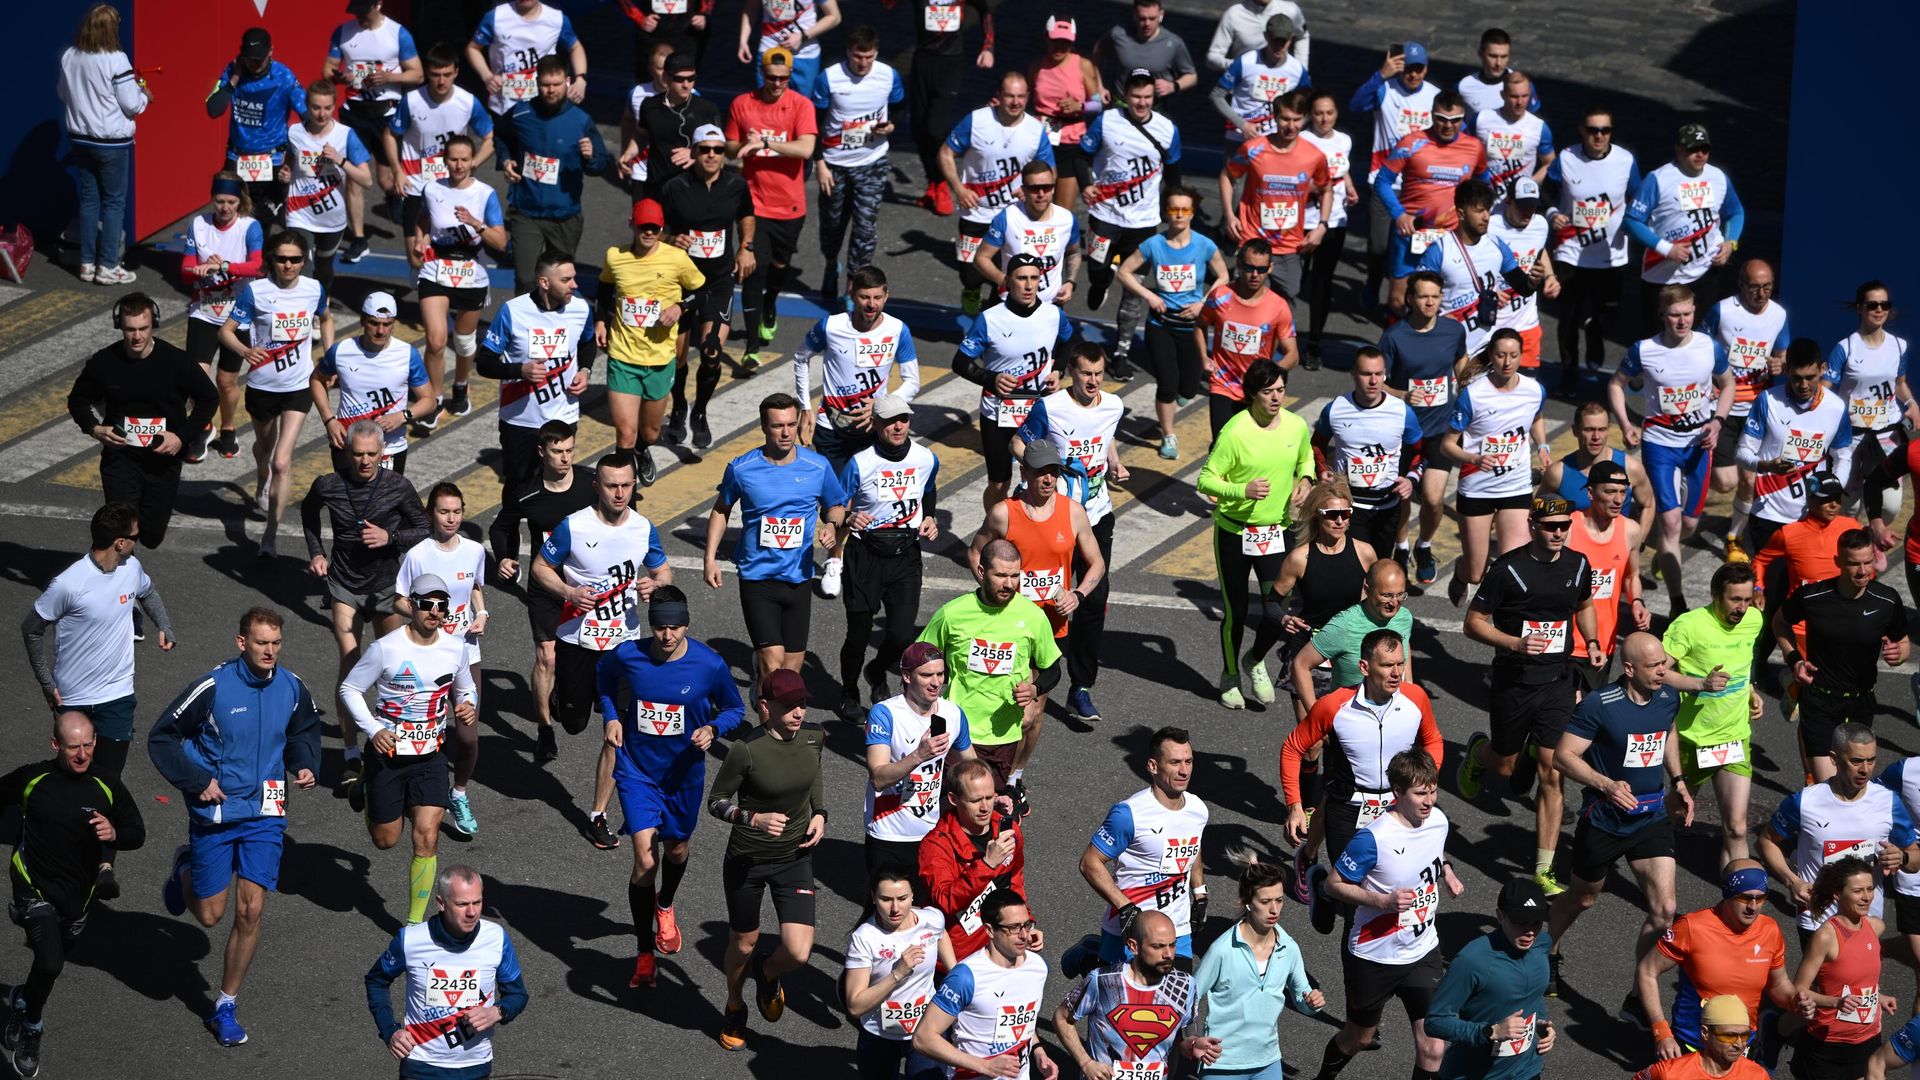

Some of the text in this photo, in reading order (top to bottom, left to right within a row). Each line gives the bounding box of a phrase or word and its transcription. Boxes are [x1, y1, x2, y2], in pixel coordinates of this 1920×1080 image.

[503, 81, 535, 89] 22338
[1696, 132, 1703, 140] Z
[1490, 139, 1523, 150] 20738
[239, 160, 270, 170] 20013
[424, 163, 449, 173] 200
[526, 160, 557, 172] 24533
[1129, 156, 1152, 179] ЗА
[1117, 181, 1146, 207] БЕГ
[1681, 189, 1712, 199] 20737
[1263, 208, 1297, 218] 21920
[1575, 207, 1608, 218] 20889
[1023, 234, 1057, 245] 24485
[440, 266, 474, 277] 20180
[1160, 271, 1193, 281] 20554
[274, 318, 310, 329] 20550
[531, 334, 567, 346] 23177
[1225, 329, 1258, 343] 23621
[859, 342, 895, 355] 22207
[1733, 343, 1767, 357] 20143
[855, 370, 883, 392] ЗА
[366, 387, 396, 411] ЗА
[1662, 390, 1699, 403] 22200
[1001, 405, 1031, 415] 2446
[1851, 405, 1887, 416] 30313
[127, 424, 163, 435] 20282
[1484, 442, 1521, 454] 23767
[1786, 436, 1824, 450] 20826
[1068, 443, 1103, 457] 22917
[1350, 462, 1388, 475] 23037
[880, 476, 917, 488] 22471
[763, 523, 802, 535] 20470
[1245, 531, 1281, 543] 22324
[608, 559, 636, 588] ЗА
[1022, 574, 1062, 588] 20832
[1590, 576, 1612, 586] 634
[447, 611, 467, 624] 951
[583, 626, 623, 638] 23732
[972, 645, 1013, 661] 24585
[640, 708, 682, 722] 22193
[399, 728, 439, 741] 24066
[1629, 740, 1663, 753] 24221
[907, 778, 940, 792] 23206
[266, 788, 285, 800] 239
[1165, 845, 1199, 859] 21956
[1410, 892, 1438, 910] 4593
[430, 978, 478, 991] 22436
[999, 1009, 1036, 1026] 23662
[439, 1014, 476, 1050] БЕ
[1115, 1069, 1162, 1080] 23586
